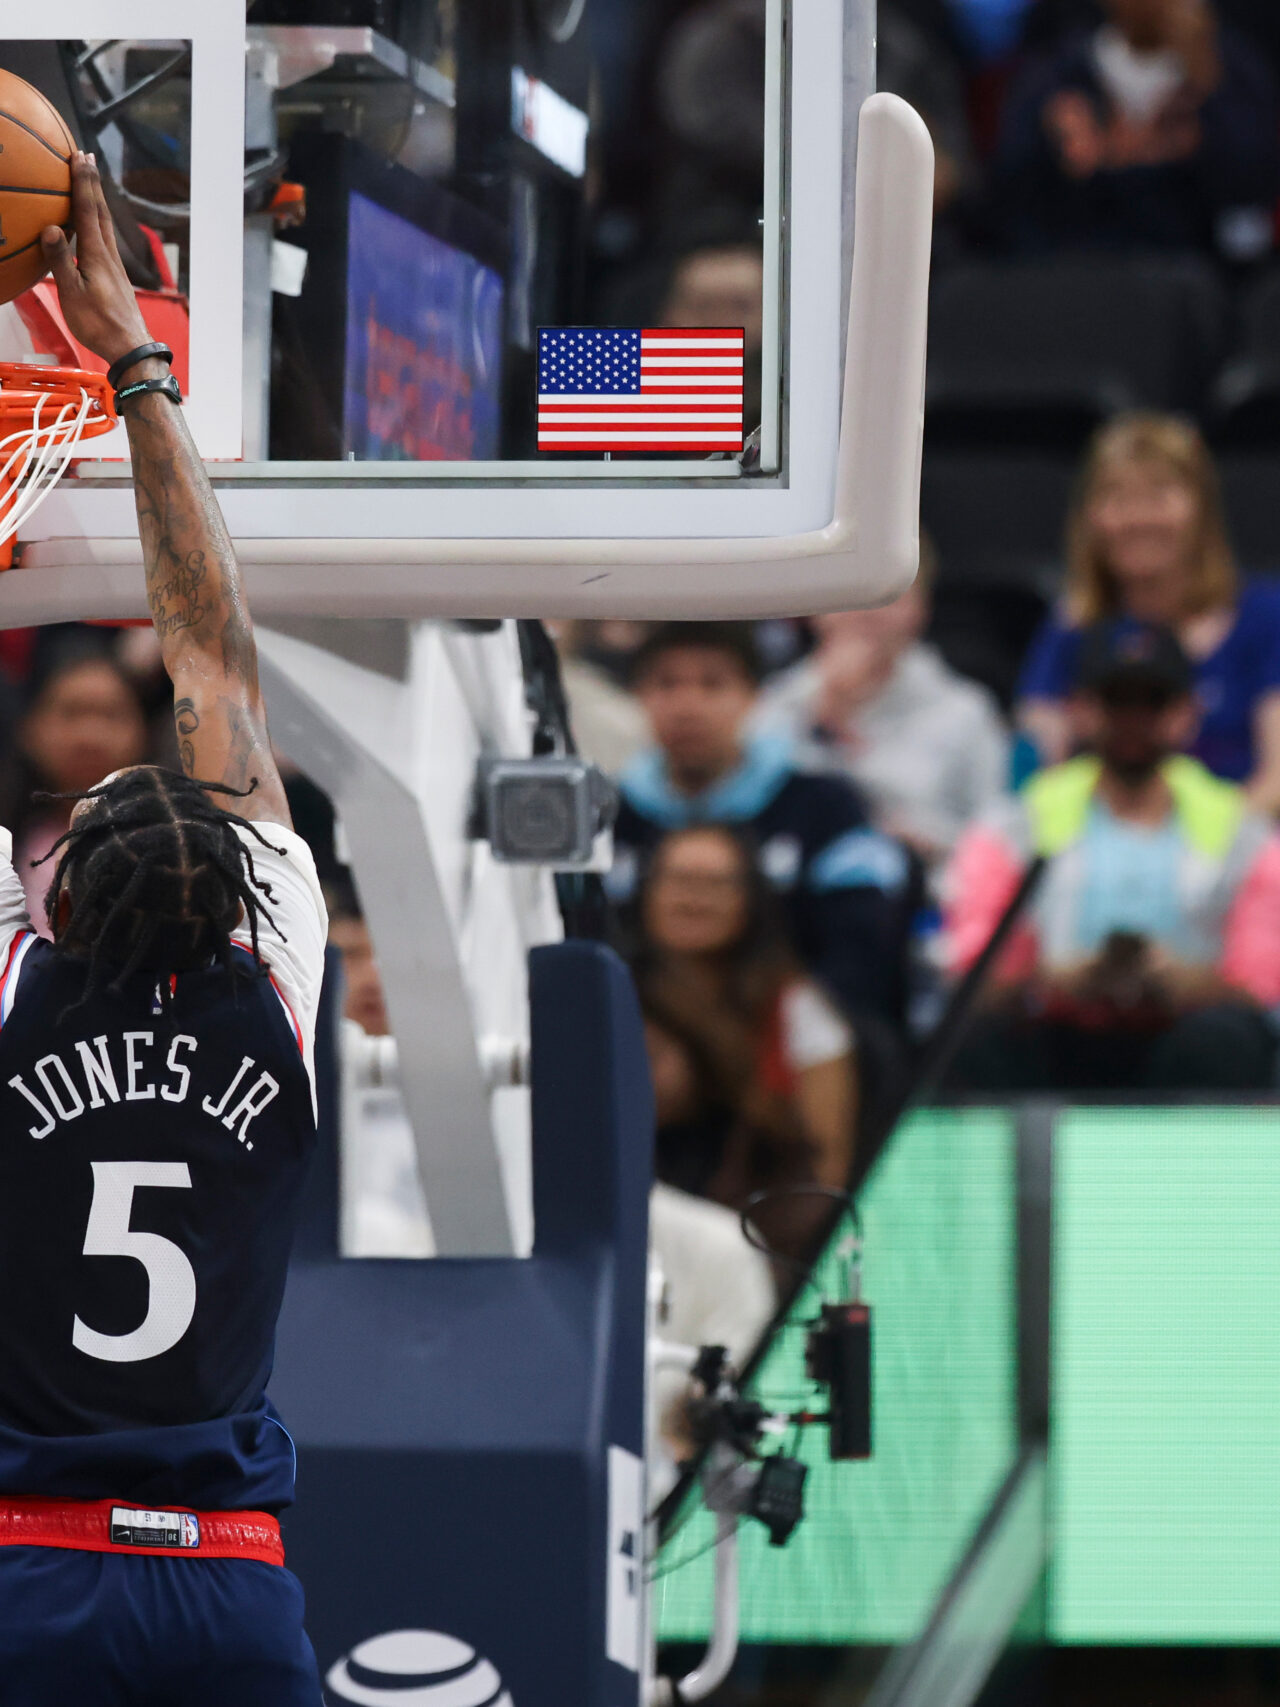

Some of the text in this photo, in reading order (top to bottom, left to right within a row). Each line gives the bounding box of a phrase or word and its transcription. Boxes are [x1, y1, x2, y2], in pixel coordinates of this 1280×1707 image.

[7, 1031, 280, 1151] JONES JR.
[72, 1161, 196, 1363] 5
